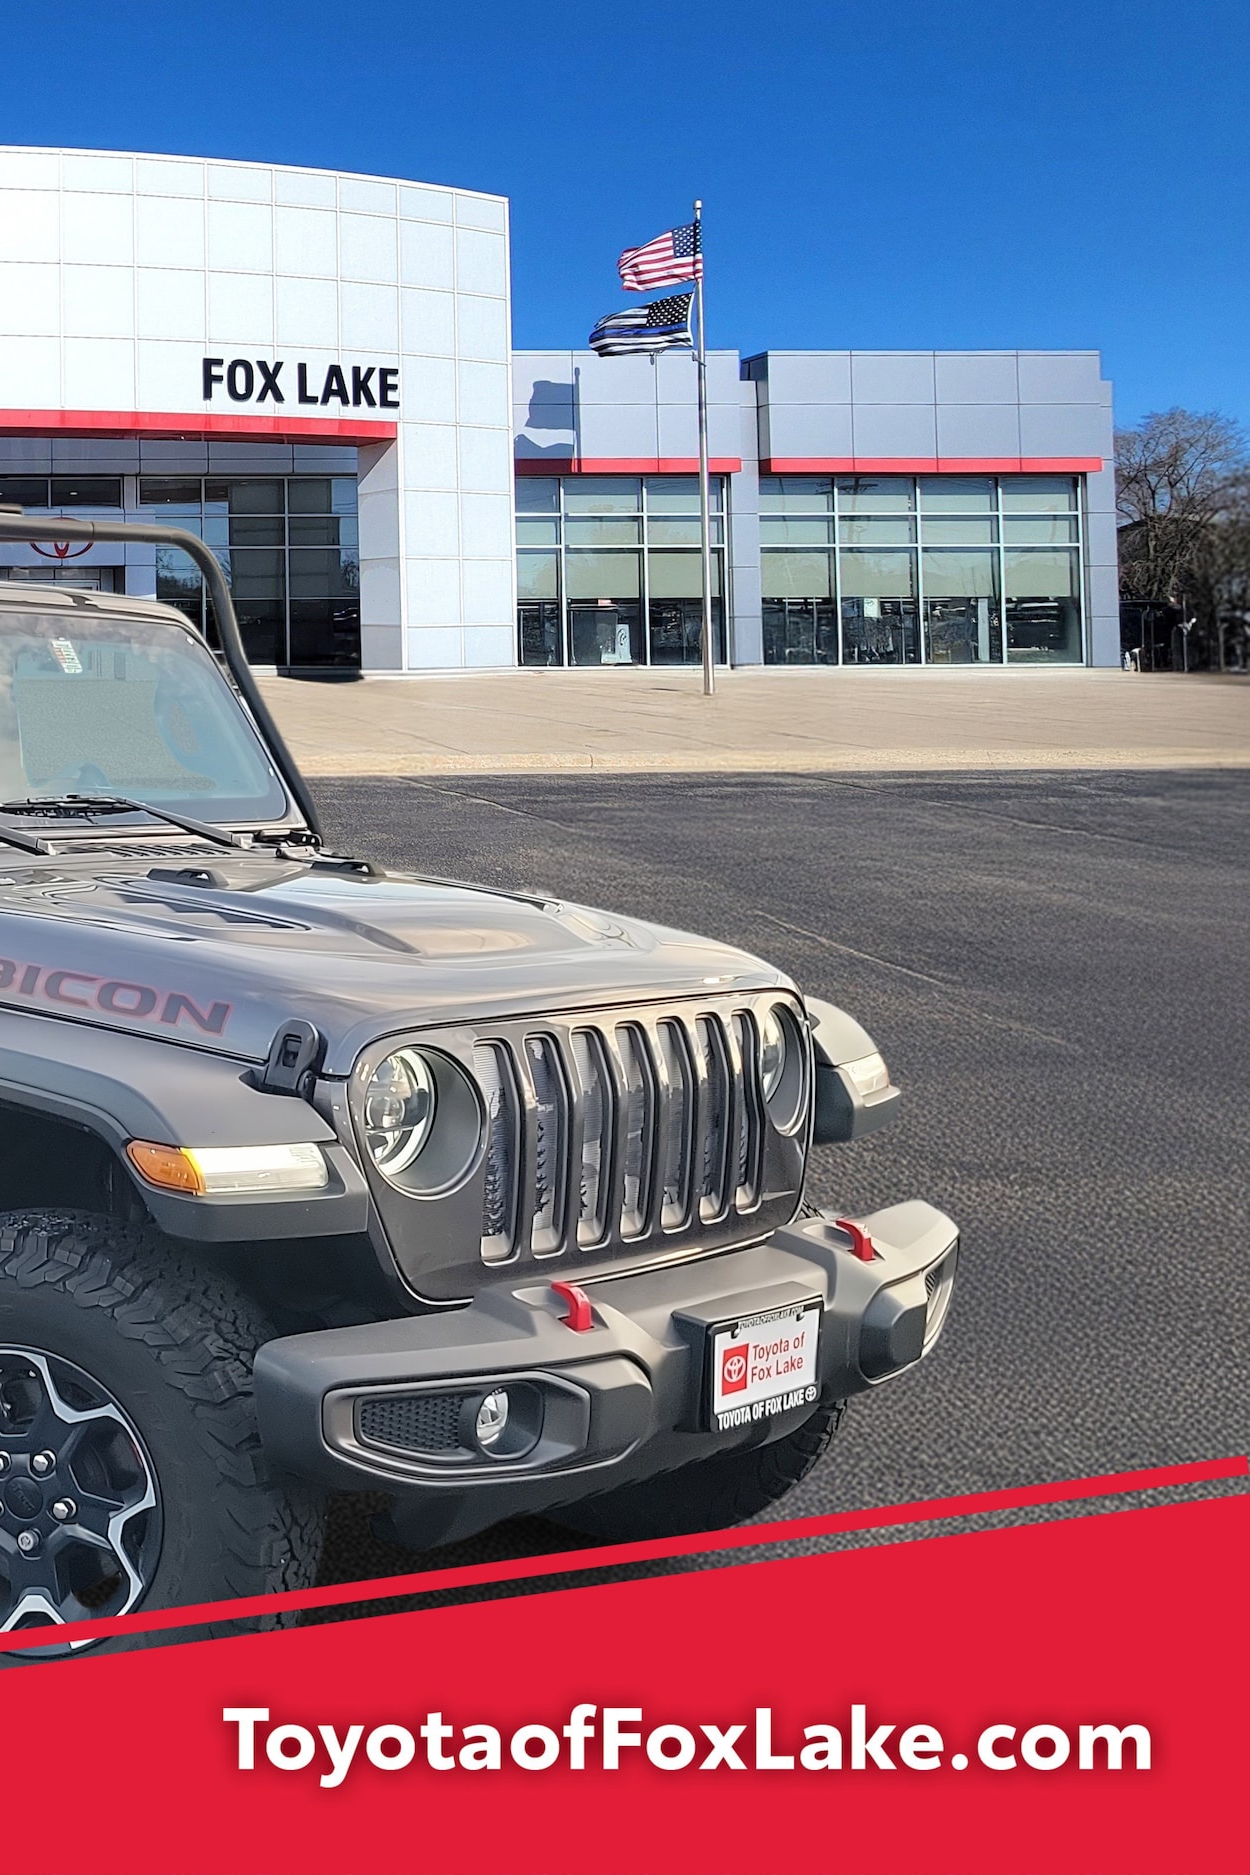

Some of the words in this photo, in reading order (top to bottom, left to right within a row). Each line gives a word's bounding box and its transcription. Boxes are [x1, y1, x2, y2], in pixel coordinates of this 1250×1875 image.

[202, 357, 285, 404] FOX
[297, 362, 400, 409] LAKE
[752, 1338, 789, 1361] Toyota
[793, 1331, 805, 1349] of
[751, 1366, 772, 1383] Fox
[776, 1355, 804, 1376] Lake
[717, 1405, 751, 1431] TOYOTA
[752, 1401, 765, 1420] OF
[765, 1396, 783, 1417] FOX
[783, 1388, 805, 1411] LAKE
